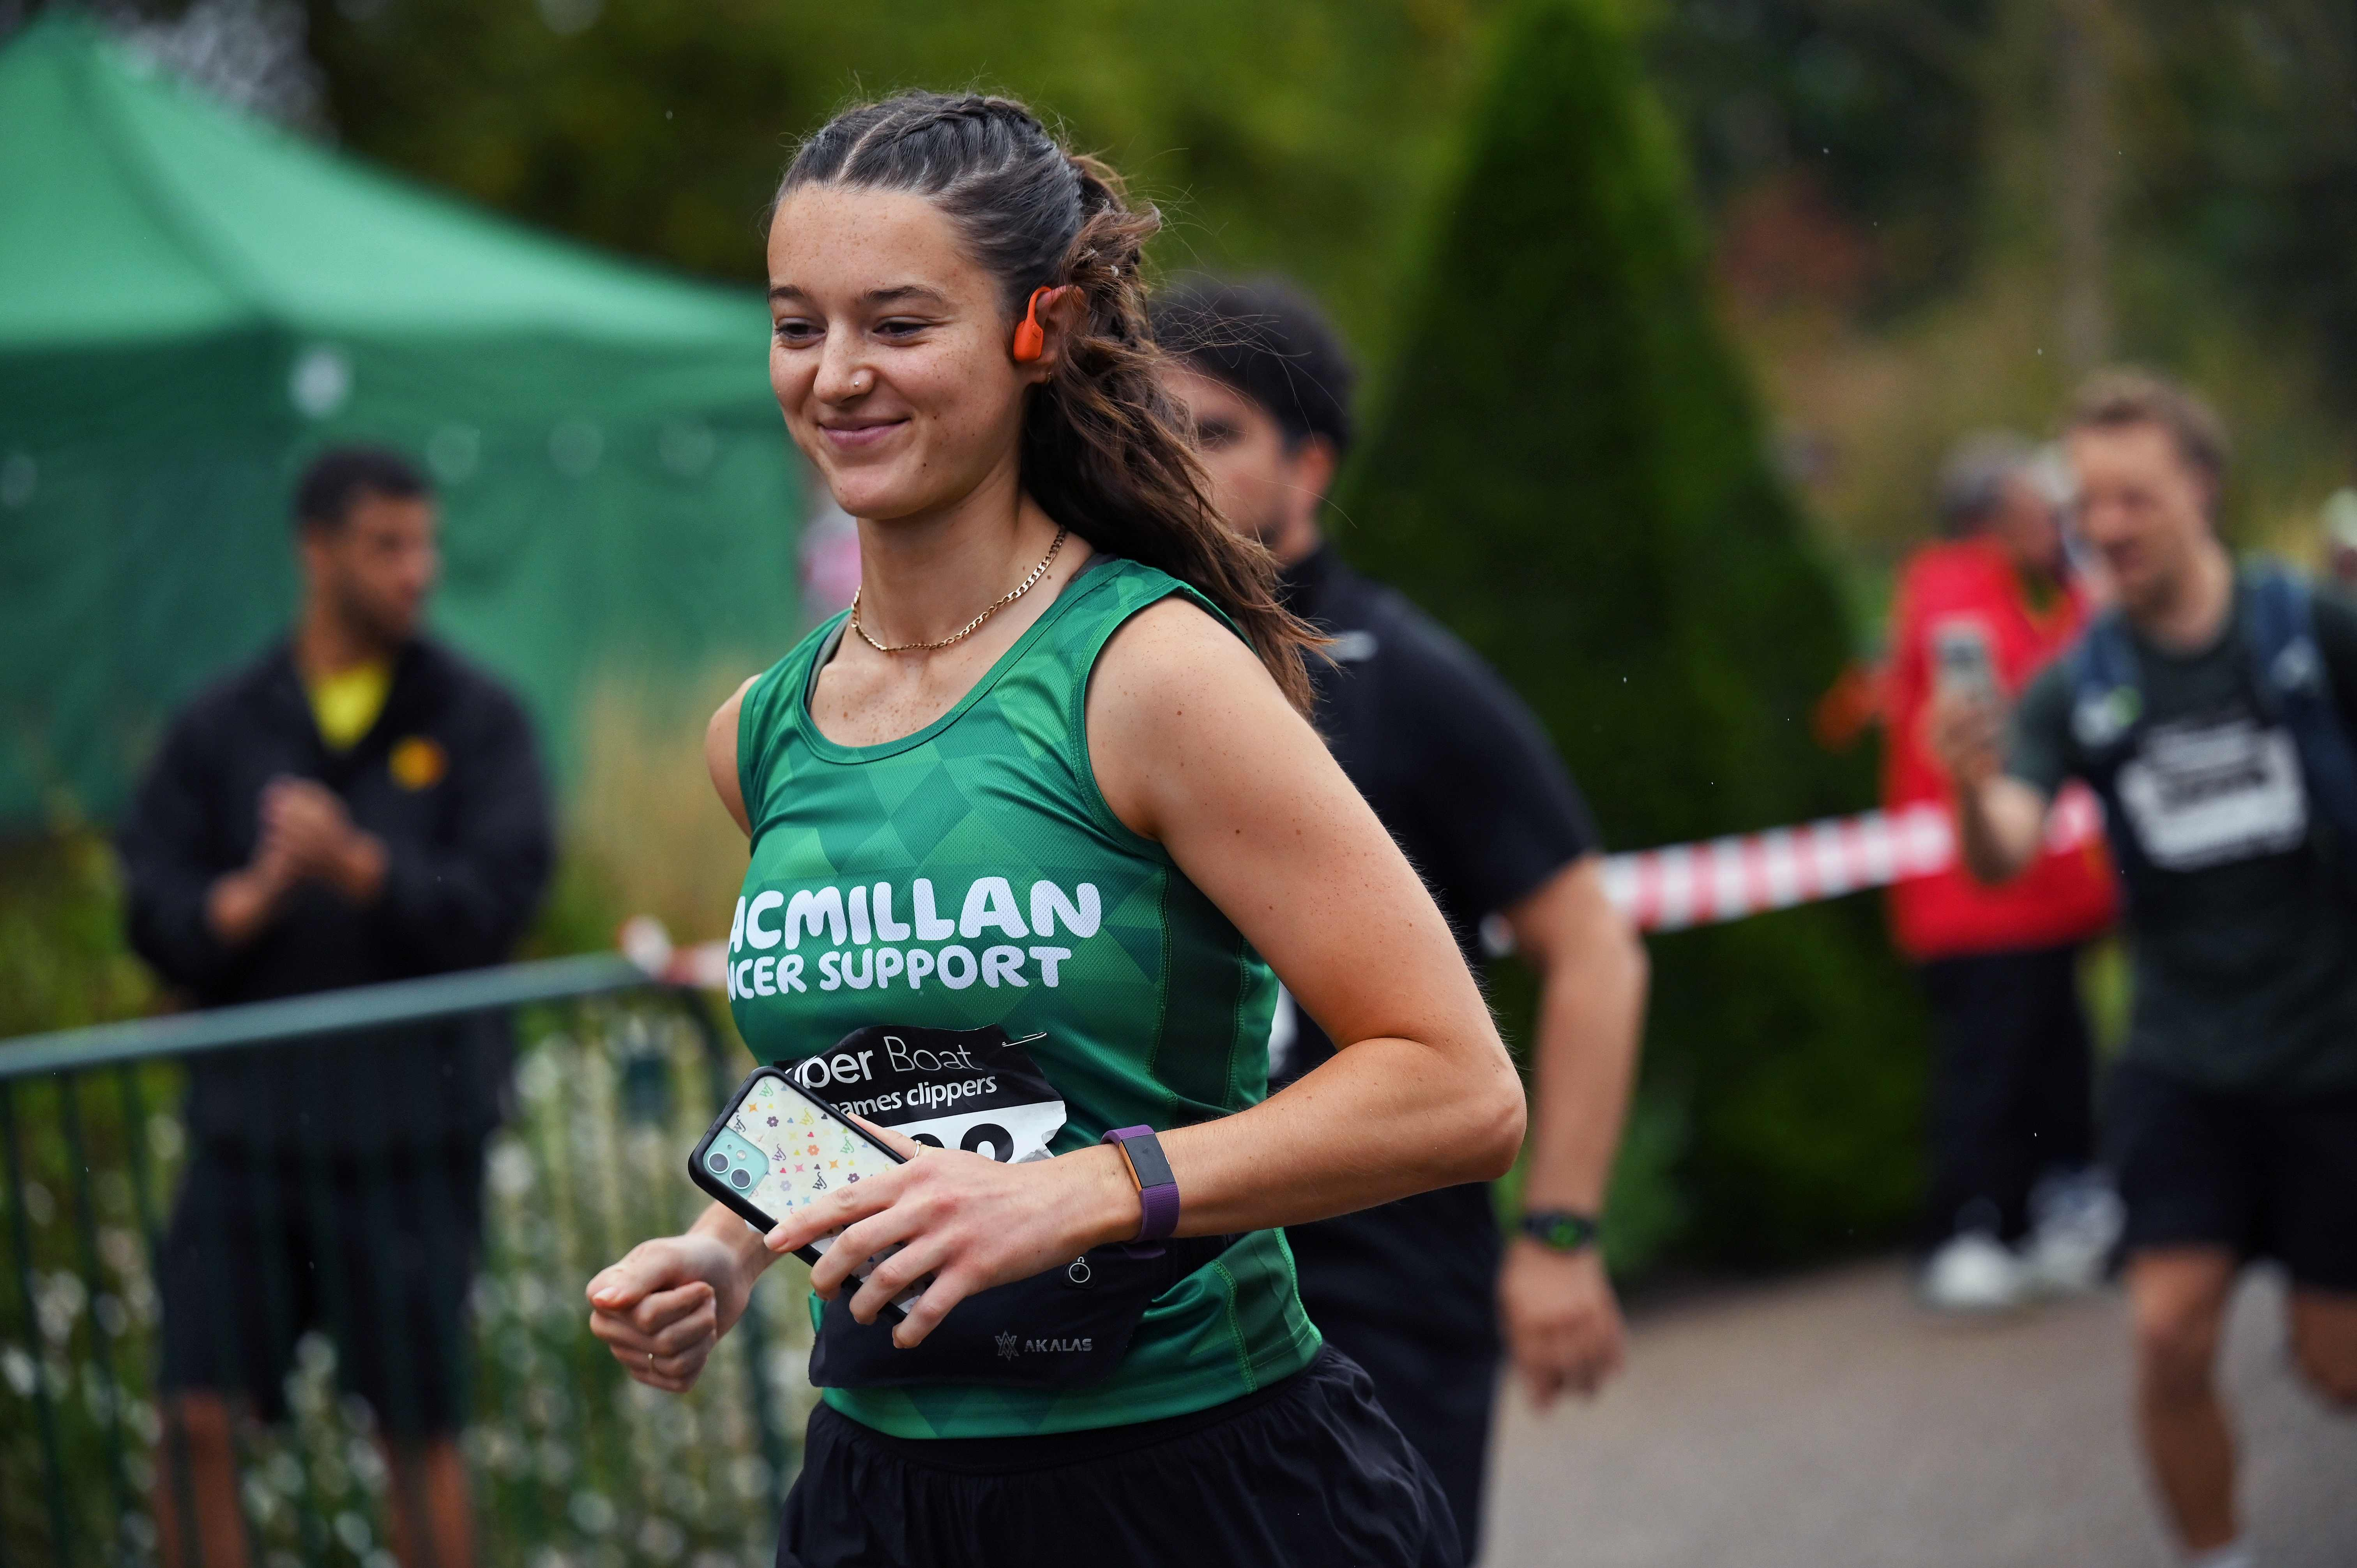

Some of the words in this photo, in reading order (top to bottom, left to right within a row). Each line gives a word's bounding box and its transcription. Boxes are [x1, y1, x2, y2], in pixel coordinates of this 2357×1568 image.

[818, 945, 1072, 991] SUPPORT
[883, 1036, 982, 1072] Boat
[830, 1091, 902, 1118] ames
[906, 1076, 997, 1109] clippers
[1024, 1338, 1093, 1352] AKALAS
